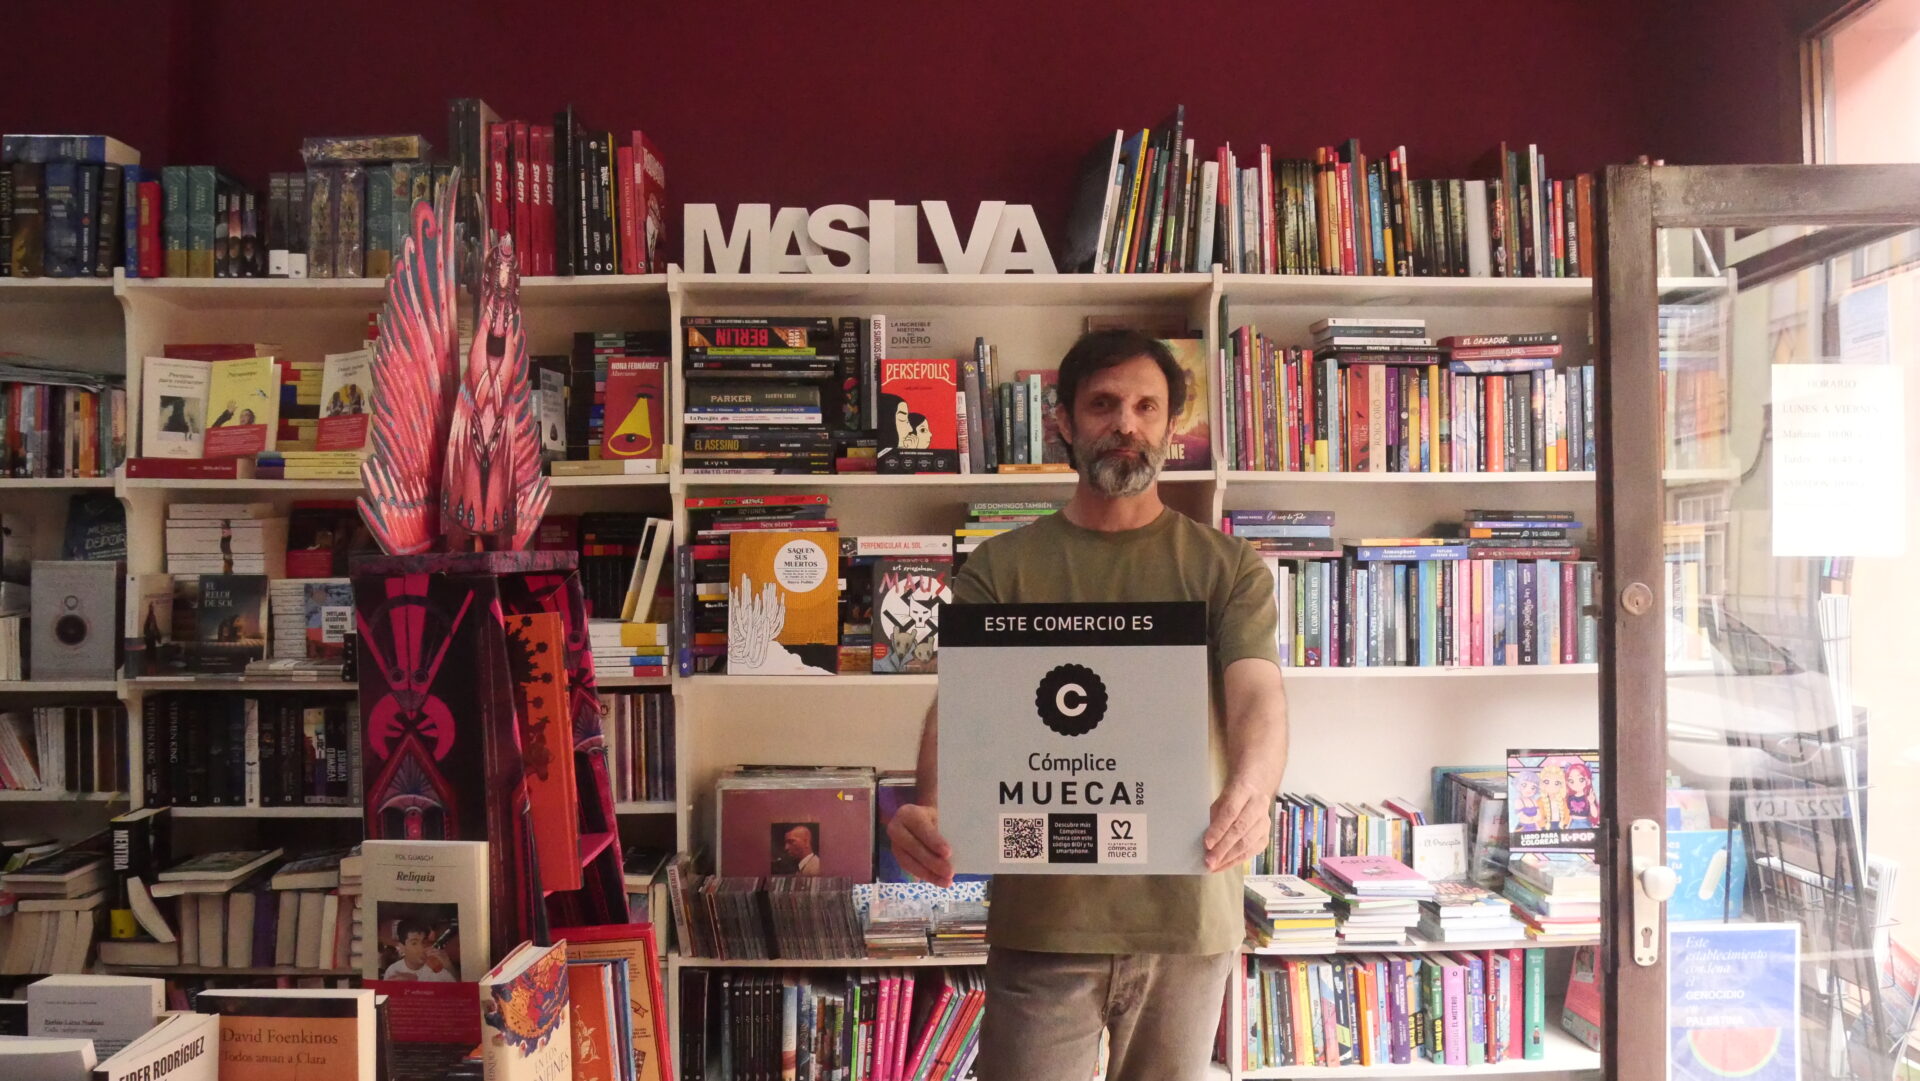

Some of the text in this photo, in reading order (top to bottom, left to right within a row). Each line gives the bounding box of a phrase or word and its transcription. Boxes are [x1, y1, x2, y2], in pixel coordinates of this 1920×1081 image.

[715, 328, 769, 346] BERLIN
[891, 336, 931, 344] DINERO
[886, 361, 950, 380] PERSÉPOLIS
[710, 395, 752, 403] PARKER
[1783, 404, 1818, 414] LUNES
[694, 440, 739, 450] EL ASESINO
[879, 572, 946, 597] MAUS
[984, 616, 1154, 632] ESTE COMERCIO ES
[1028, 752, 1116, 776] Cómplice
[999, 781, 1132, 804] MUECA
[1136, 782, 1144, 806] 2026
[114, 830, 129, 870] MENTIRA
[396, 871, 436, 883] Reliquia
[1686, 936, 1710, 948] Este
[1685, 948, 1768, 960] establecimiento
[1686, 990, 1744, 1000] GENOCIDIO
[1686, 1015, 1744, 1026] PALESTINA
[223, 1028, 338, 1044] David Foenkinos
[152, 1036, 205, 1079] RODRÍGUEZ
[223, 1051, 252, 1063] Todos
[256, 1054, 284, 1064] aman
[296, 1052, 326, 1065] Clara
